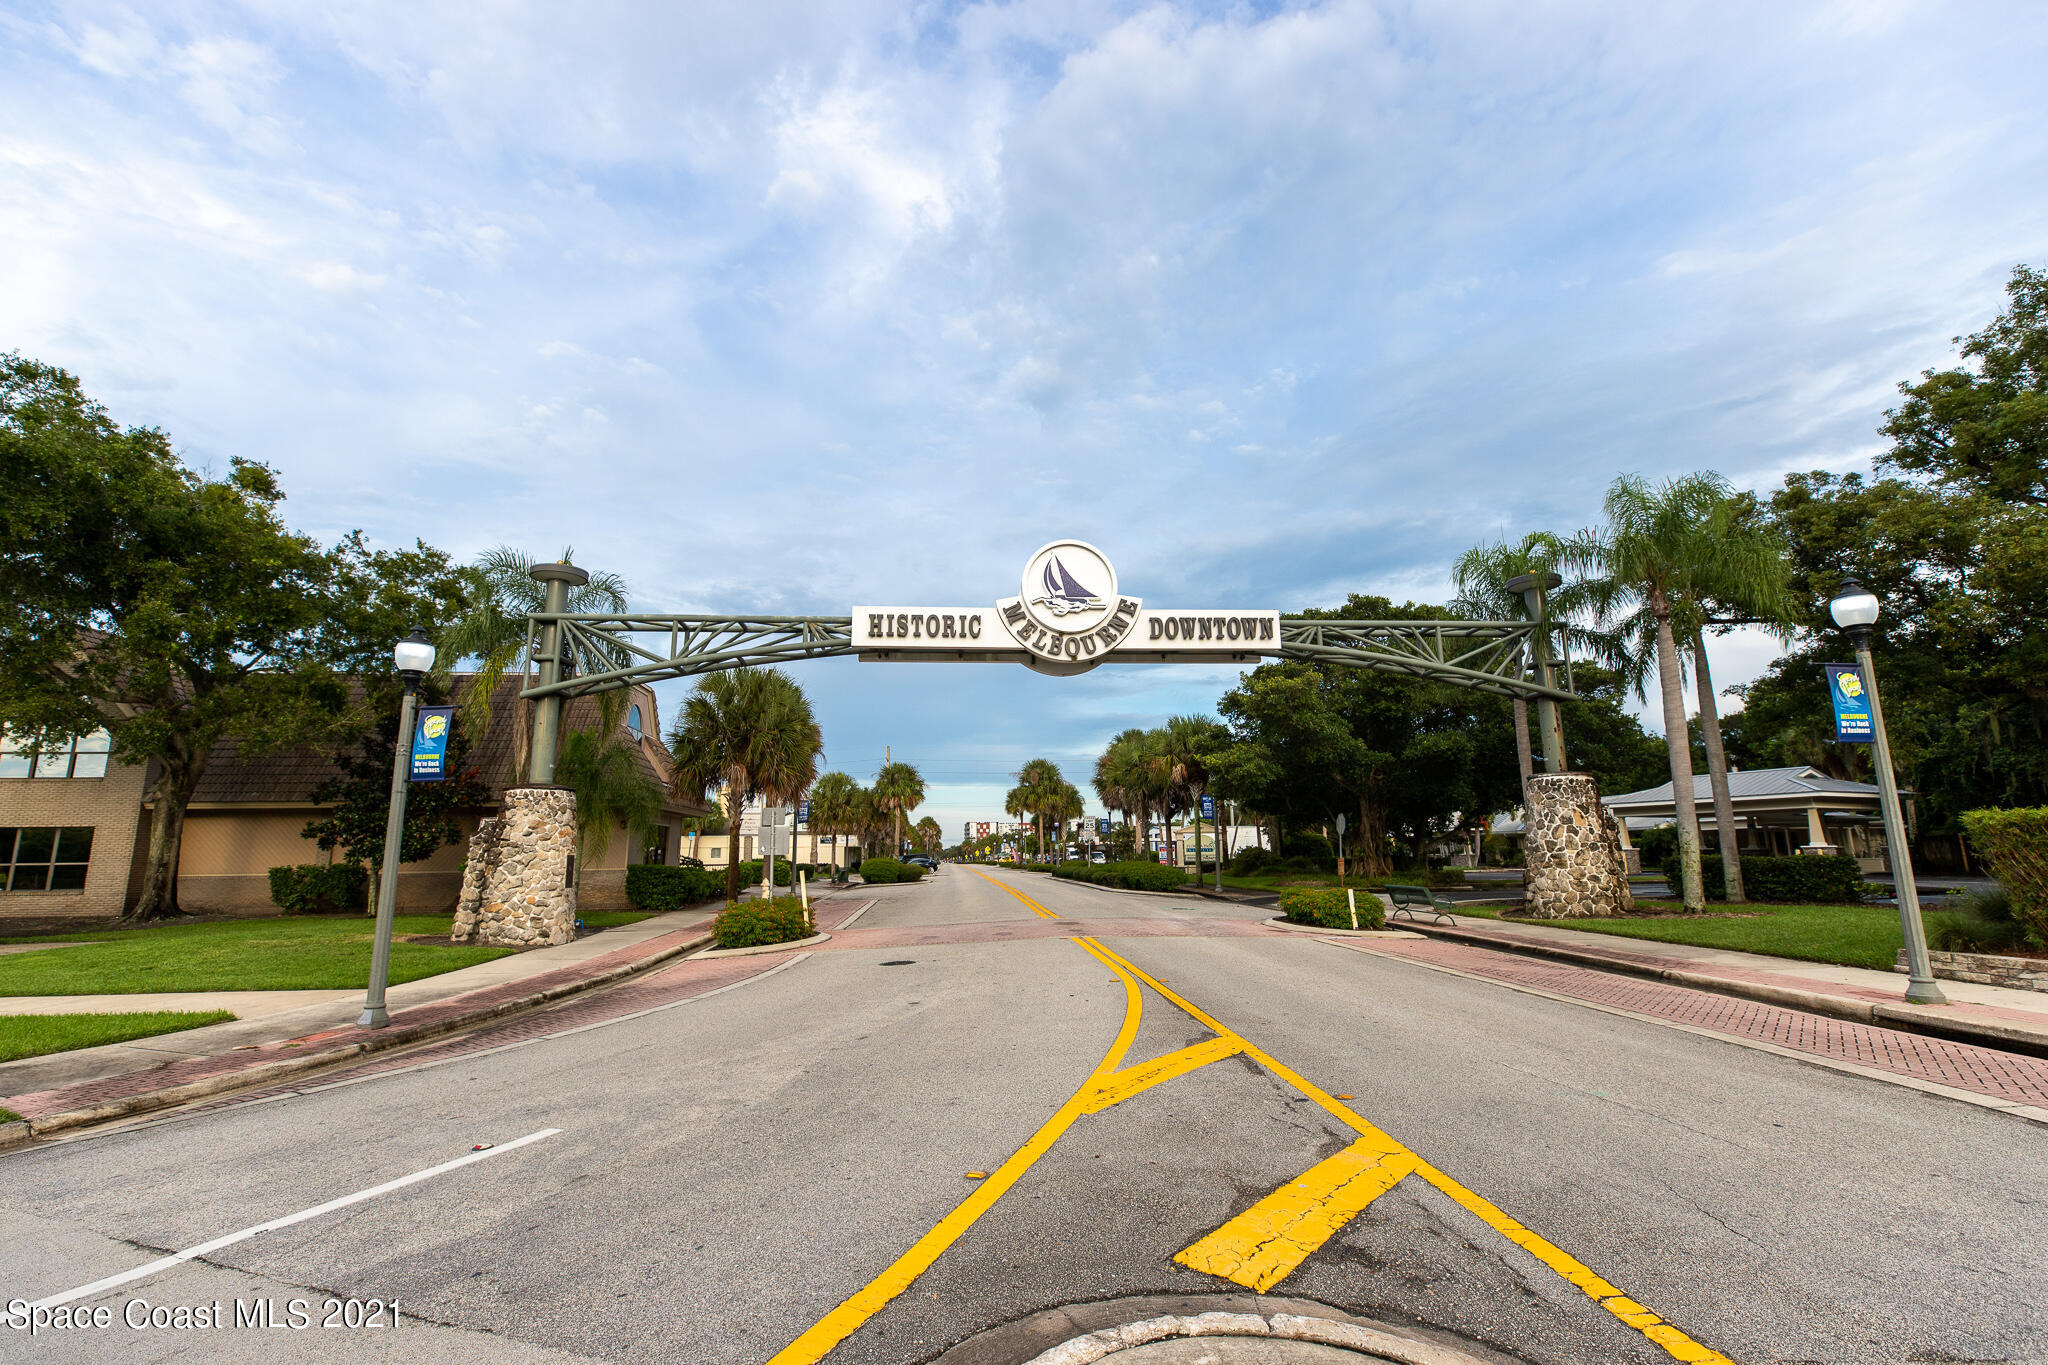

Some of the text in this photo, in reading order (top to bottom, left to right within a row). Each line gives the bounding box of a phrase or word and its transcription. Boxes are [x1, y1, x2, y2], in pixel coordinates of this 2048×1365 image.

[868, 613, 982, 639] HISTORIC
[1002, 599, 1138, 657] MELBOURNE
[1149, 616, 1274, 641] DOWNTOWN
